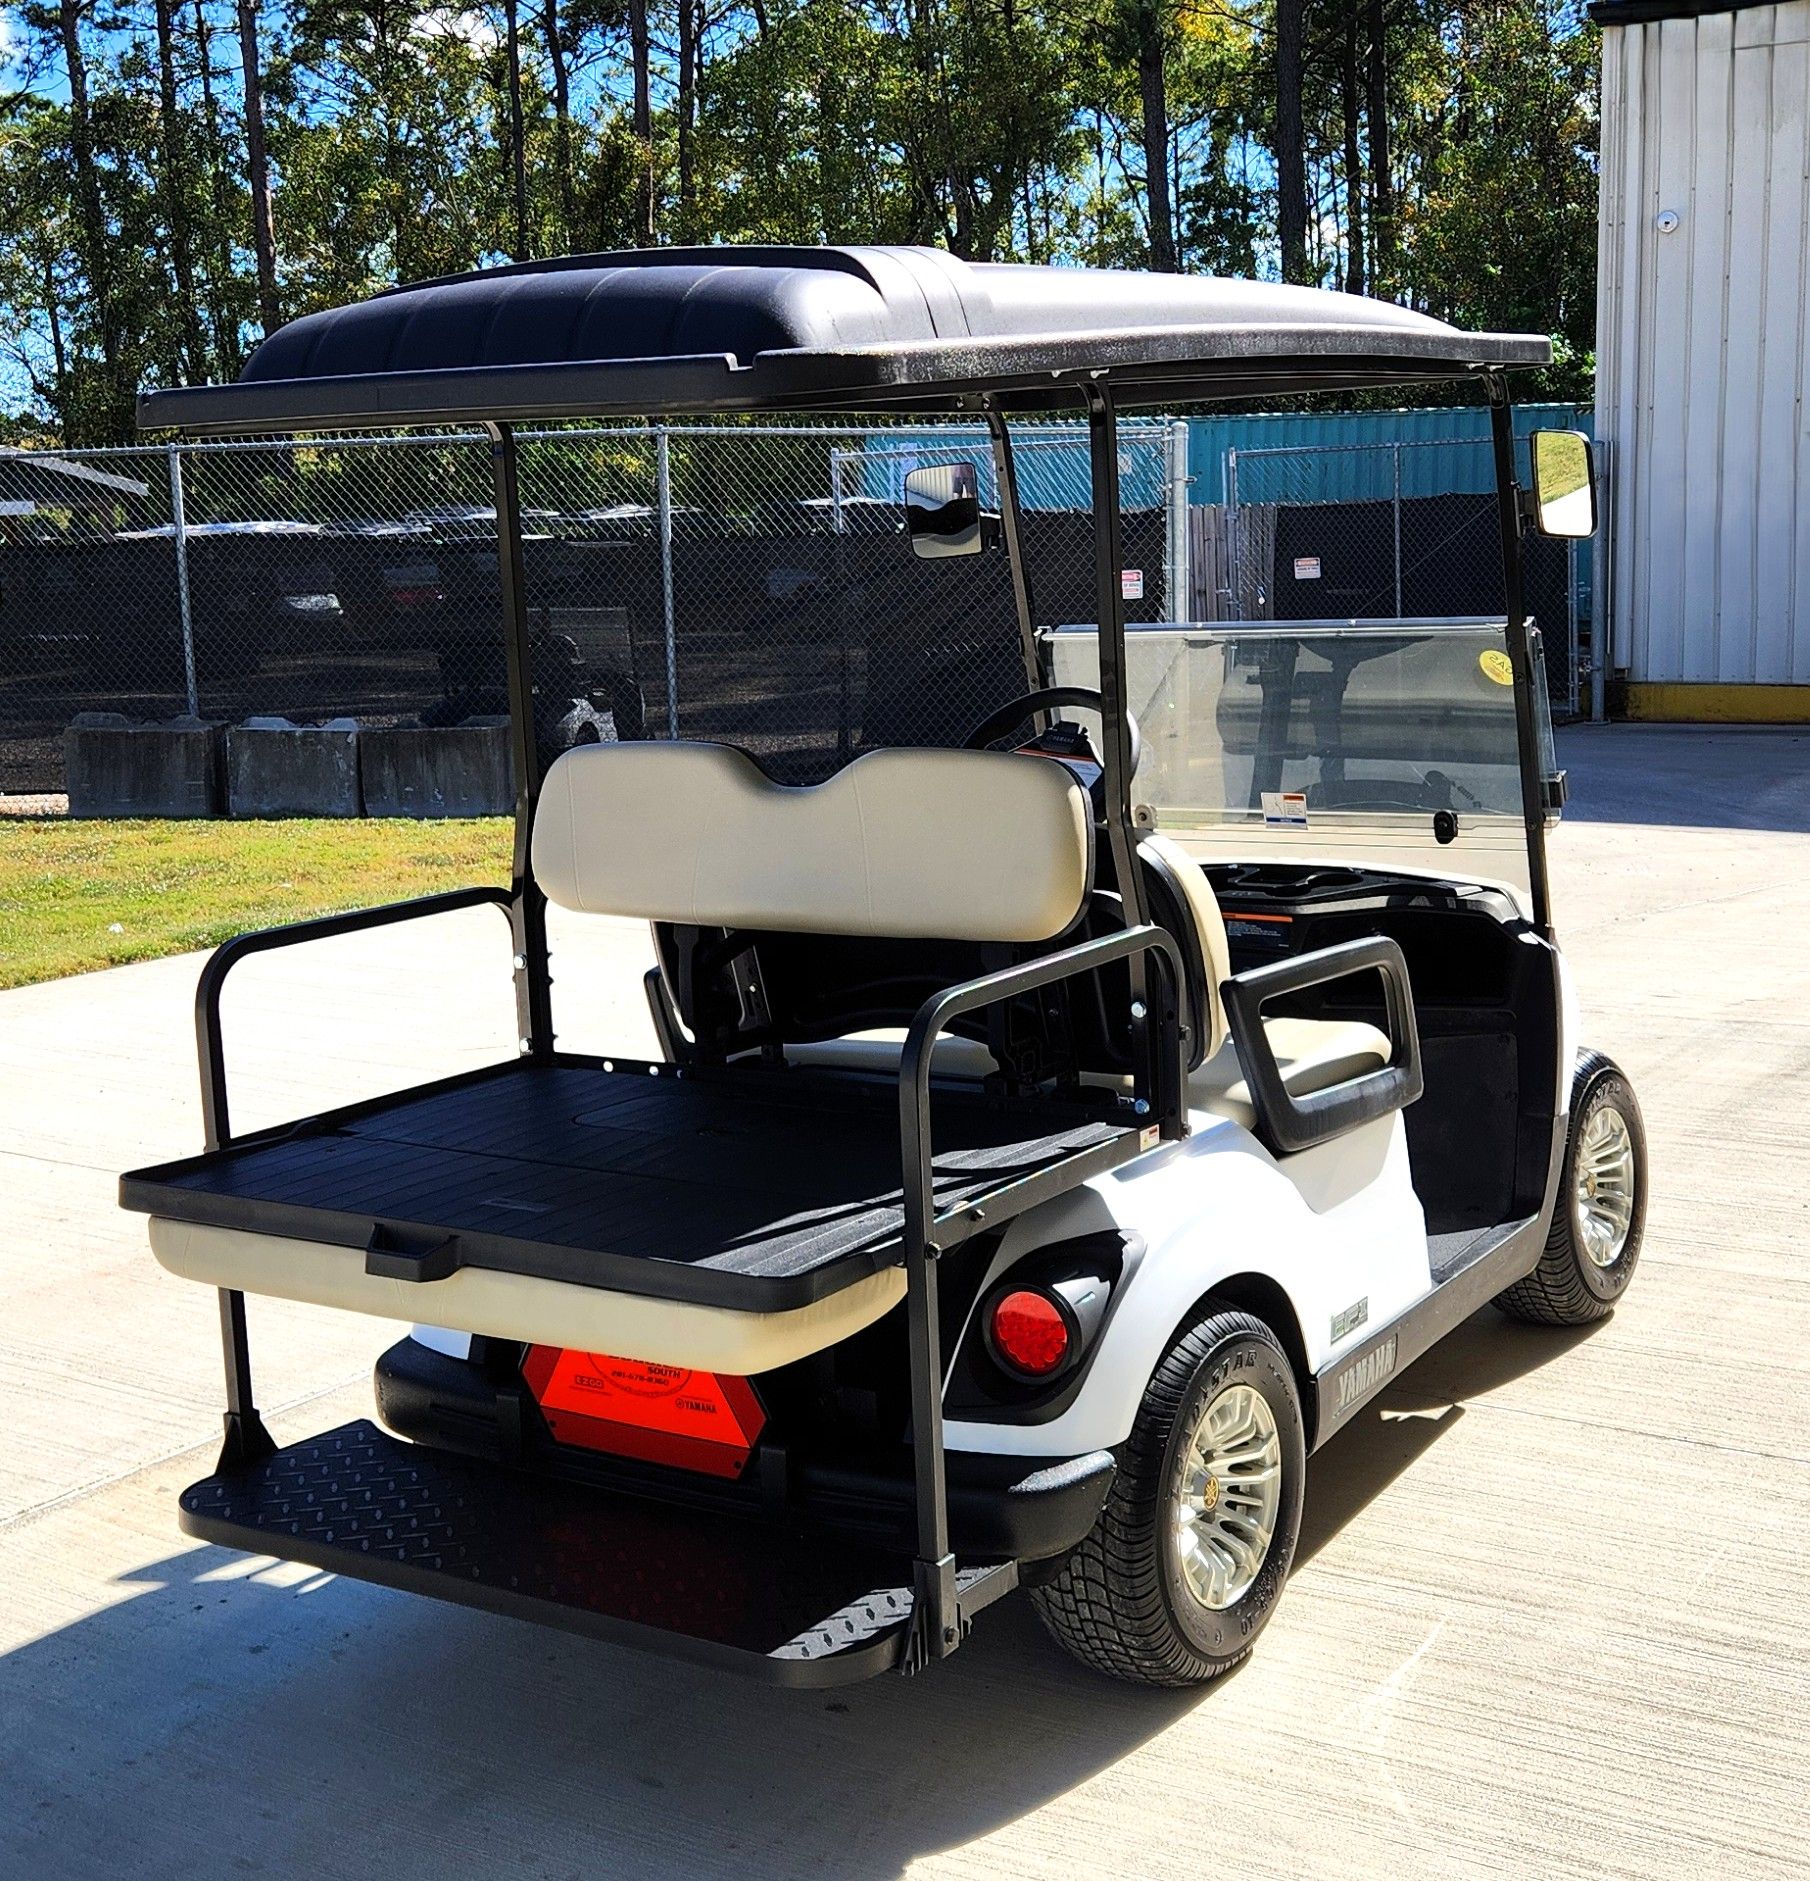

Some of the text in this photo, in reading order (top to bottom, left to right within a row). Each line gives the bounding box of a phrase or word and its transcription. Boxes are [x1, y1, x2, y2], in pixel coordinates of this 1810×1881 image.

[647, 1366, 681, 1379] SOUTH
[1338, 1339, 1396, 1407] YAMAHA
[684, 1400, 717, 1413] YAMAHA
